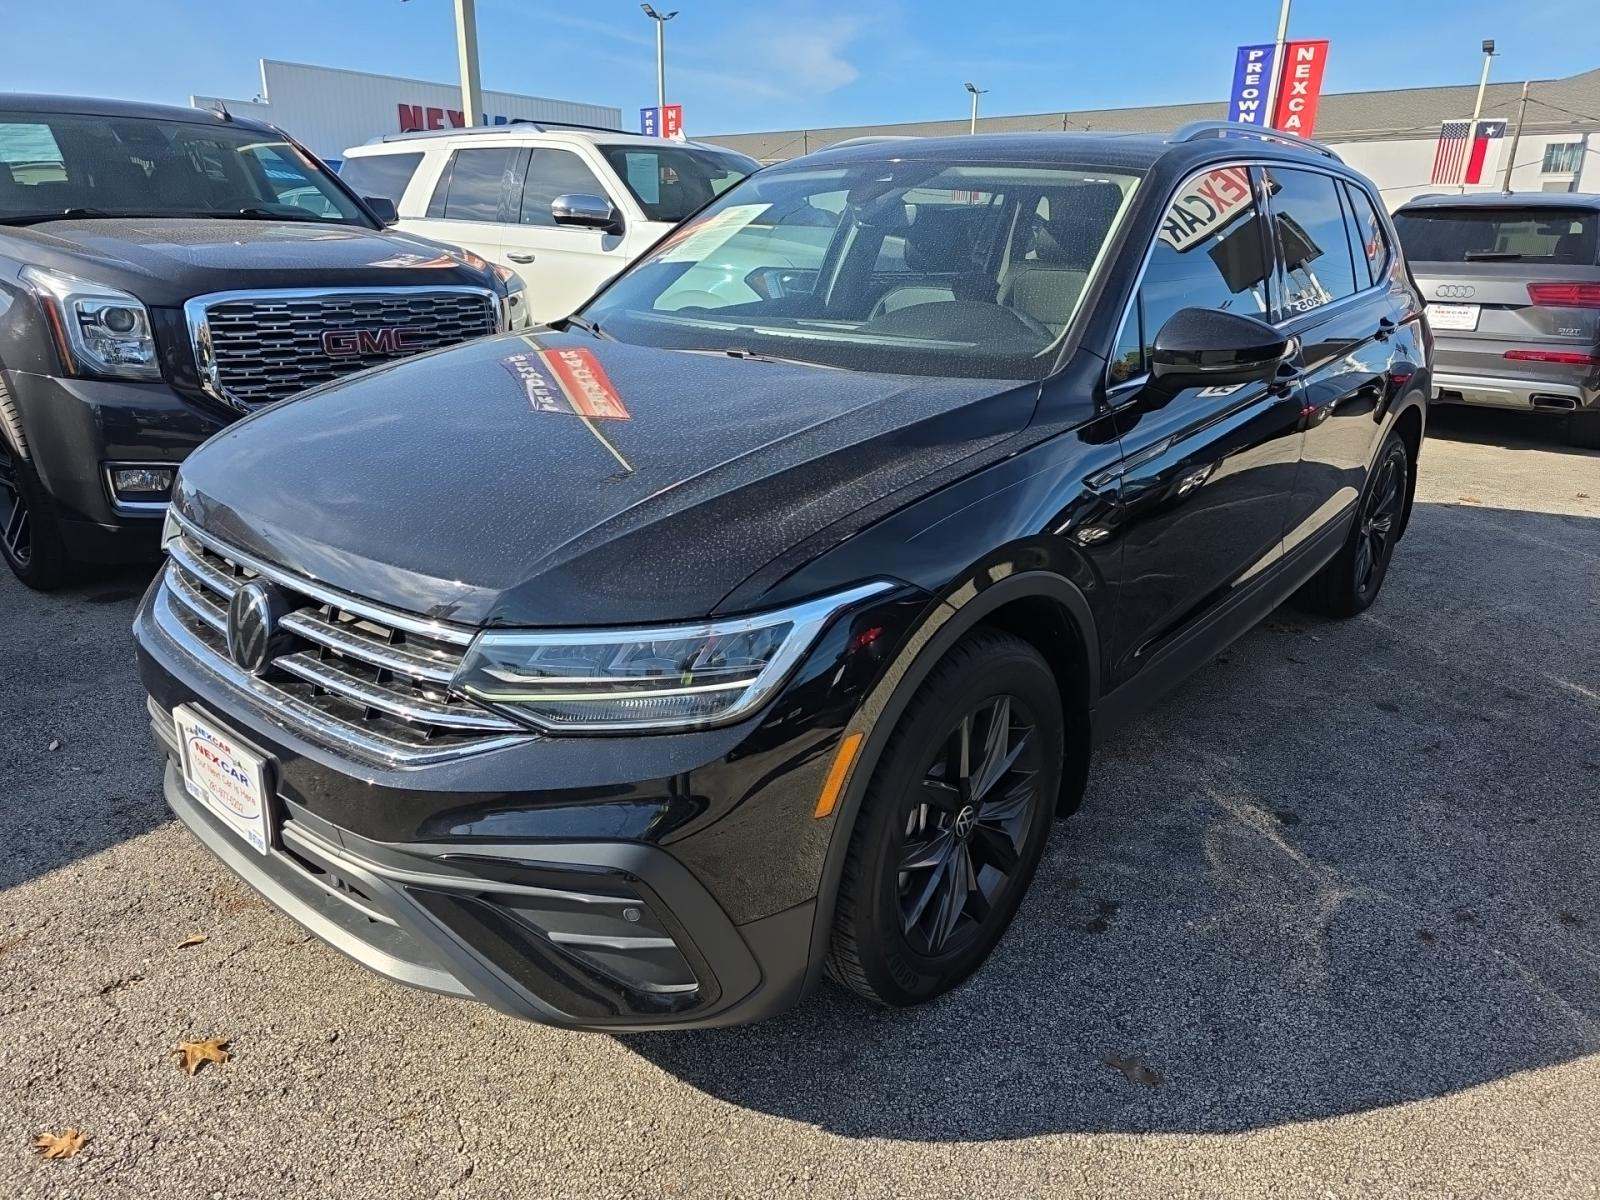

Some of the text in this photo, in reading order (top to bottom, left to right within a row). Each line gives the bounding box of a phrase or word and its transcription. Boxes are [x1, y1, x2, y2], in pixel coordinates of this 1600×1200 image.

[1284, 46, 1315, 136] NEXCA
[322, 327, 422, 356] GMC
[194, 741, 249, 788] NEXCAR
